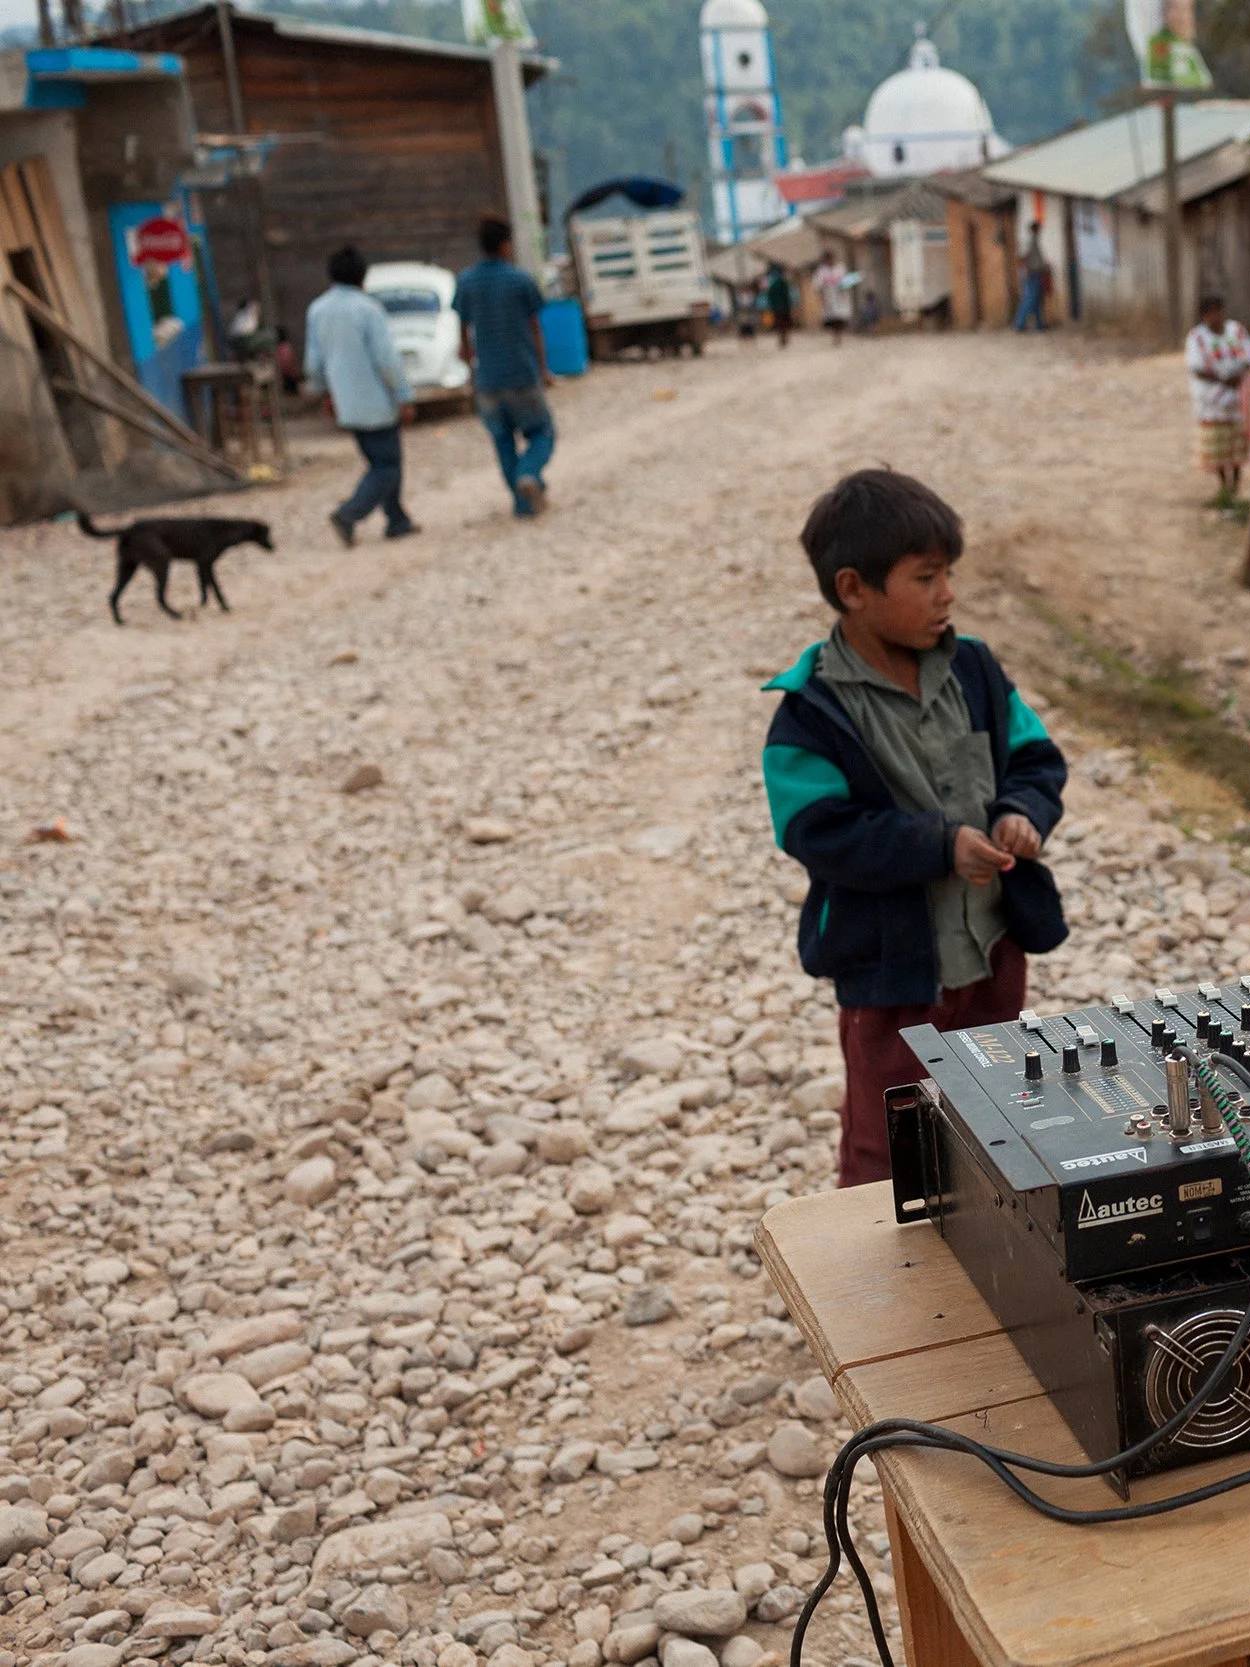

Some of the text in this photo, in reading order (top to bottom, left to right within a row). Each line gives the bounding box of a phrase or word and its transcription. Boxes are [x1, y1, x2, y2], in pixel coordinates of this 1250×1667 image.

[1188, 1139, 1230, 1151] MASTER
[1062, 1150, 1129, 1170] autec
[1183, 1185, 1202, 1198] NOM
[1097, 1194, 1164, 1218] autec
